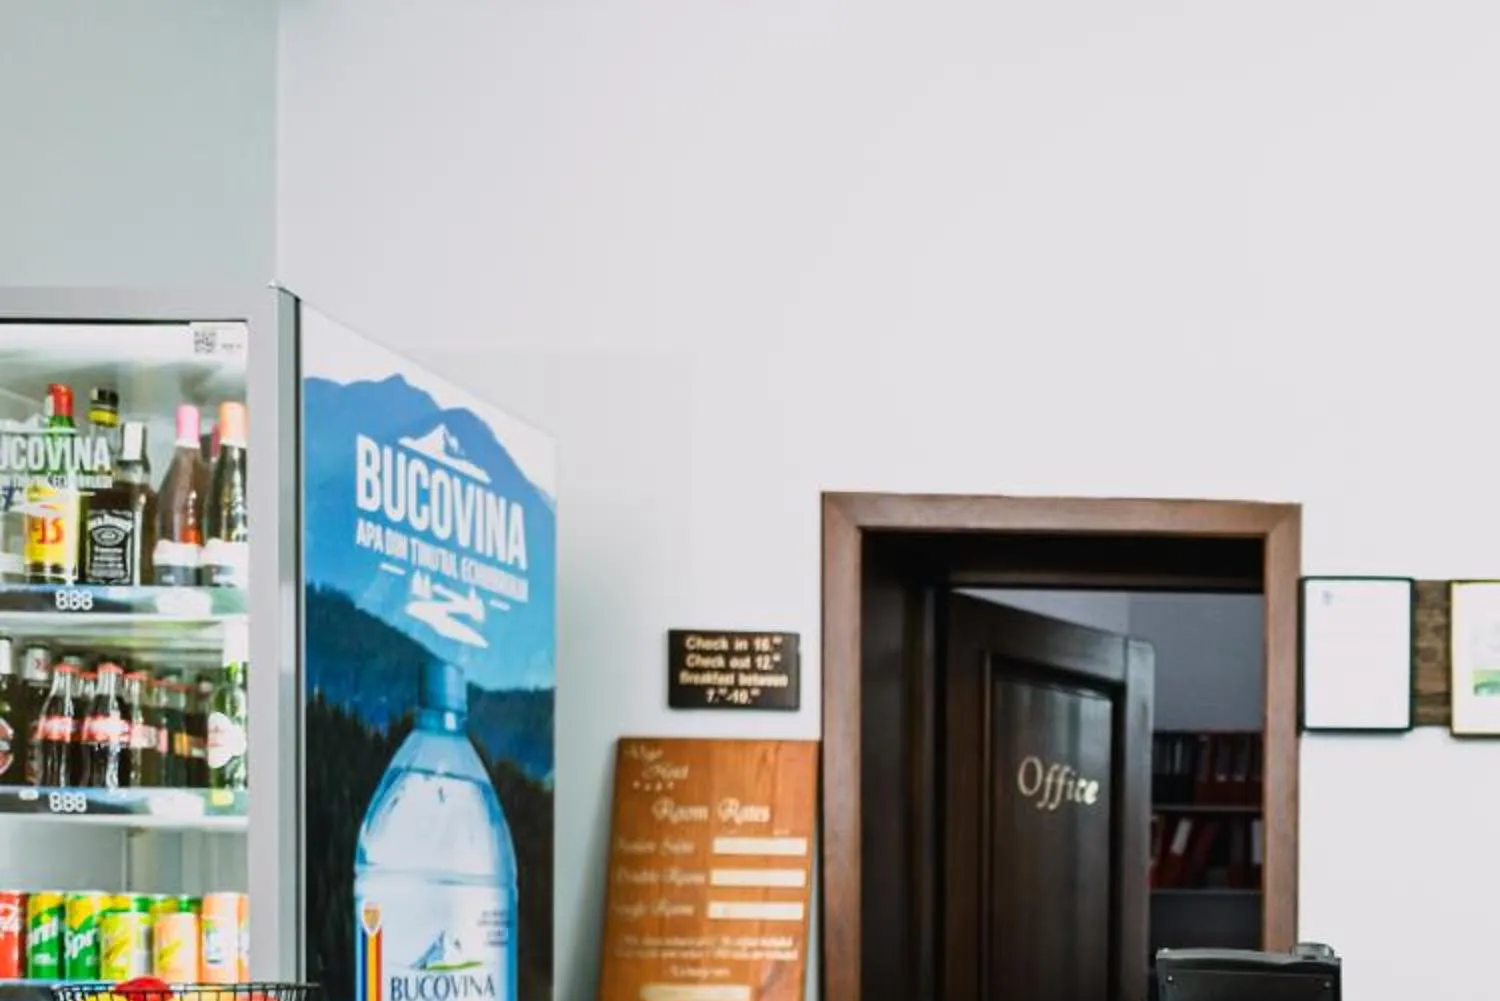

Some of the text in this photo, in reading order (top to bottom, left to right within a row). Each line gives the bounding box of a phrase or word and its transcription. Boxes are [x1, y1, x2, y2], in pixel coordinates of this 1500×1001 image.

[357, 432, 527, 571] BUCOVINA
[357, 518, 383, 553] APA
[685, 634, 729, 651] Check
[734, 636, 749, 652] in
[685, 652, 726, 669] Check
[729, 655, 751, 669] out
[1018, 756, 1099, 811] Office
